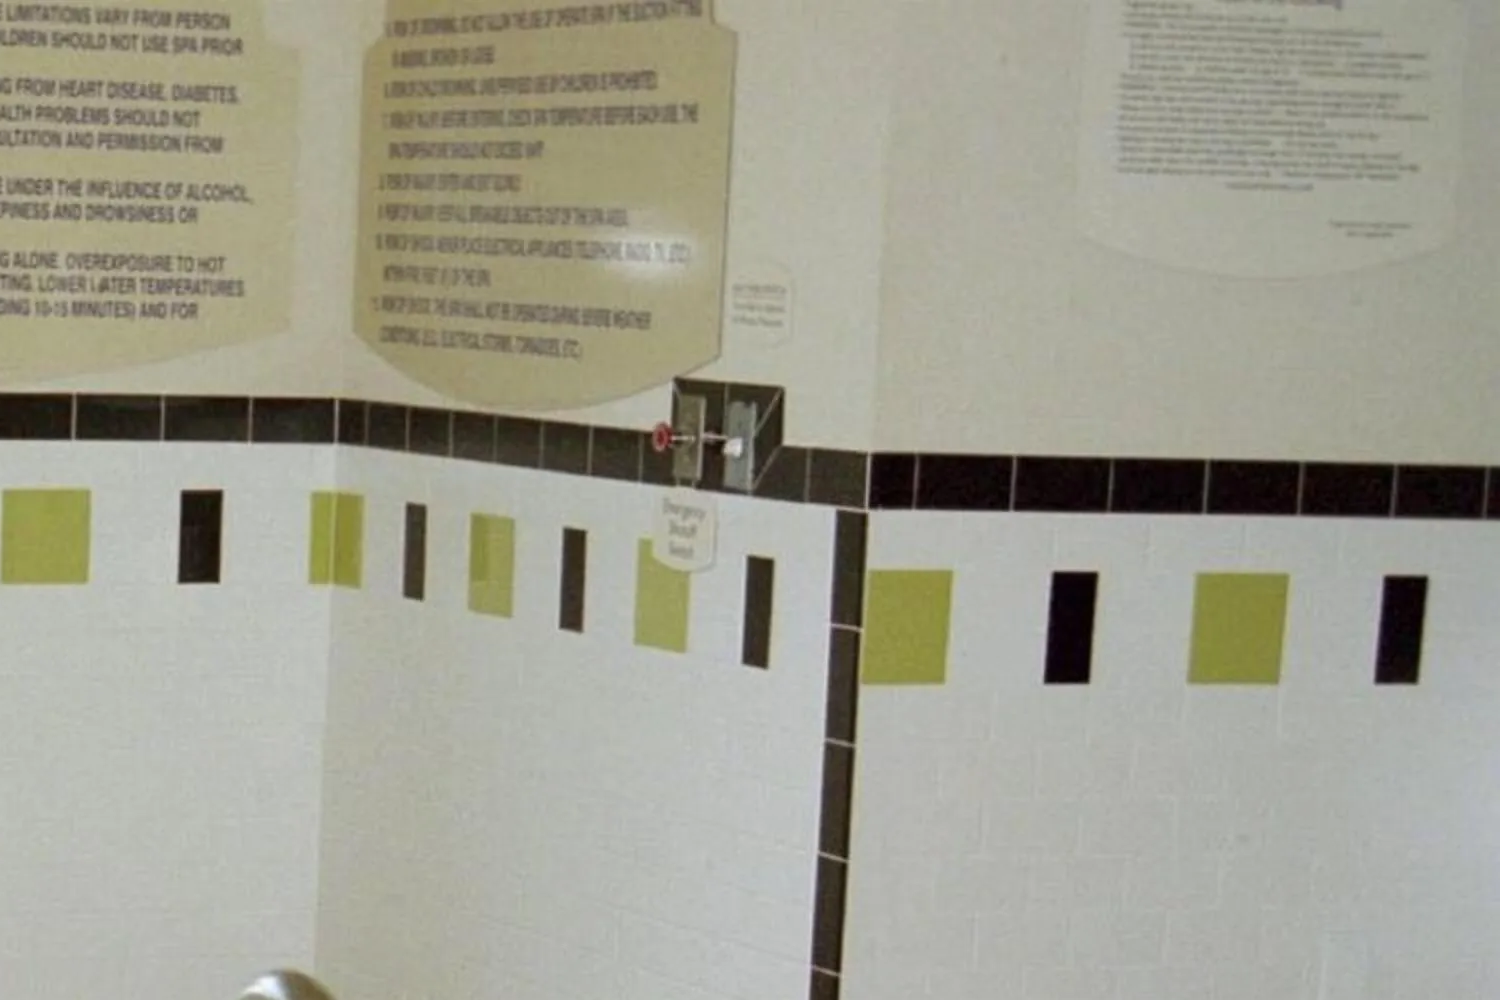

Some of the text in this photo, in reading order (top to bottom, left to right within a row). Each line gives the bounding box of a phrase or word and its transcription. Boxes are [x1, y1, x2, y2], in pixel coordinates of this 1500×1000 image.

[95, 8, 129, 26] VARY
[133, 10, 171, 28] FROM
[176, 11, 230, 30] PERSON
[52, 30, 106, 50] SHOULD
[110, 32, 139, 51] NOT
[142, 34, 168, 52] USE
[173, 35, 197, 54] SPA
[202, 36, 243, 56] PRIOR
[16, 77, 55, 96] FROM
[60, 79, 103, 98] HEART
[36, 105, 109, 124] PROBLEMS
[114, 107, 169, 126] SHOULD
[174, 109, 200, 127] NOT
[66, 131, 93, 148] AND
[98, 132, 181, 151] PERMISSION
[185, 135, 224, 152] FROM
[6, 177, 53, 197] UNDER
[57, 178, 82, 198] THE
[87, 179, 161, 200] INFLUENCE
[165, 182, 183, 201] OF
[53, 203, 82, 219] AND
[178, 206, 198, 223] OR
[66, 252, 172, 271] OVEREXPOSURE
[178, 255, 193, 271] TO
[197, 255, 226, 272] HOT
[38, 274, 86, 293] LOWER
[139, 301, 167, 318] AND
[171, 302, 198, 319] FOR
